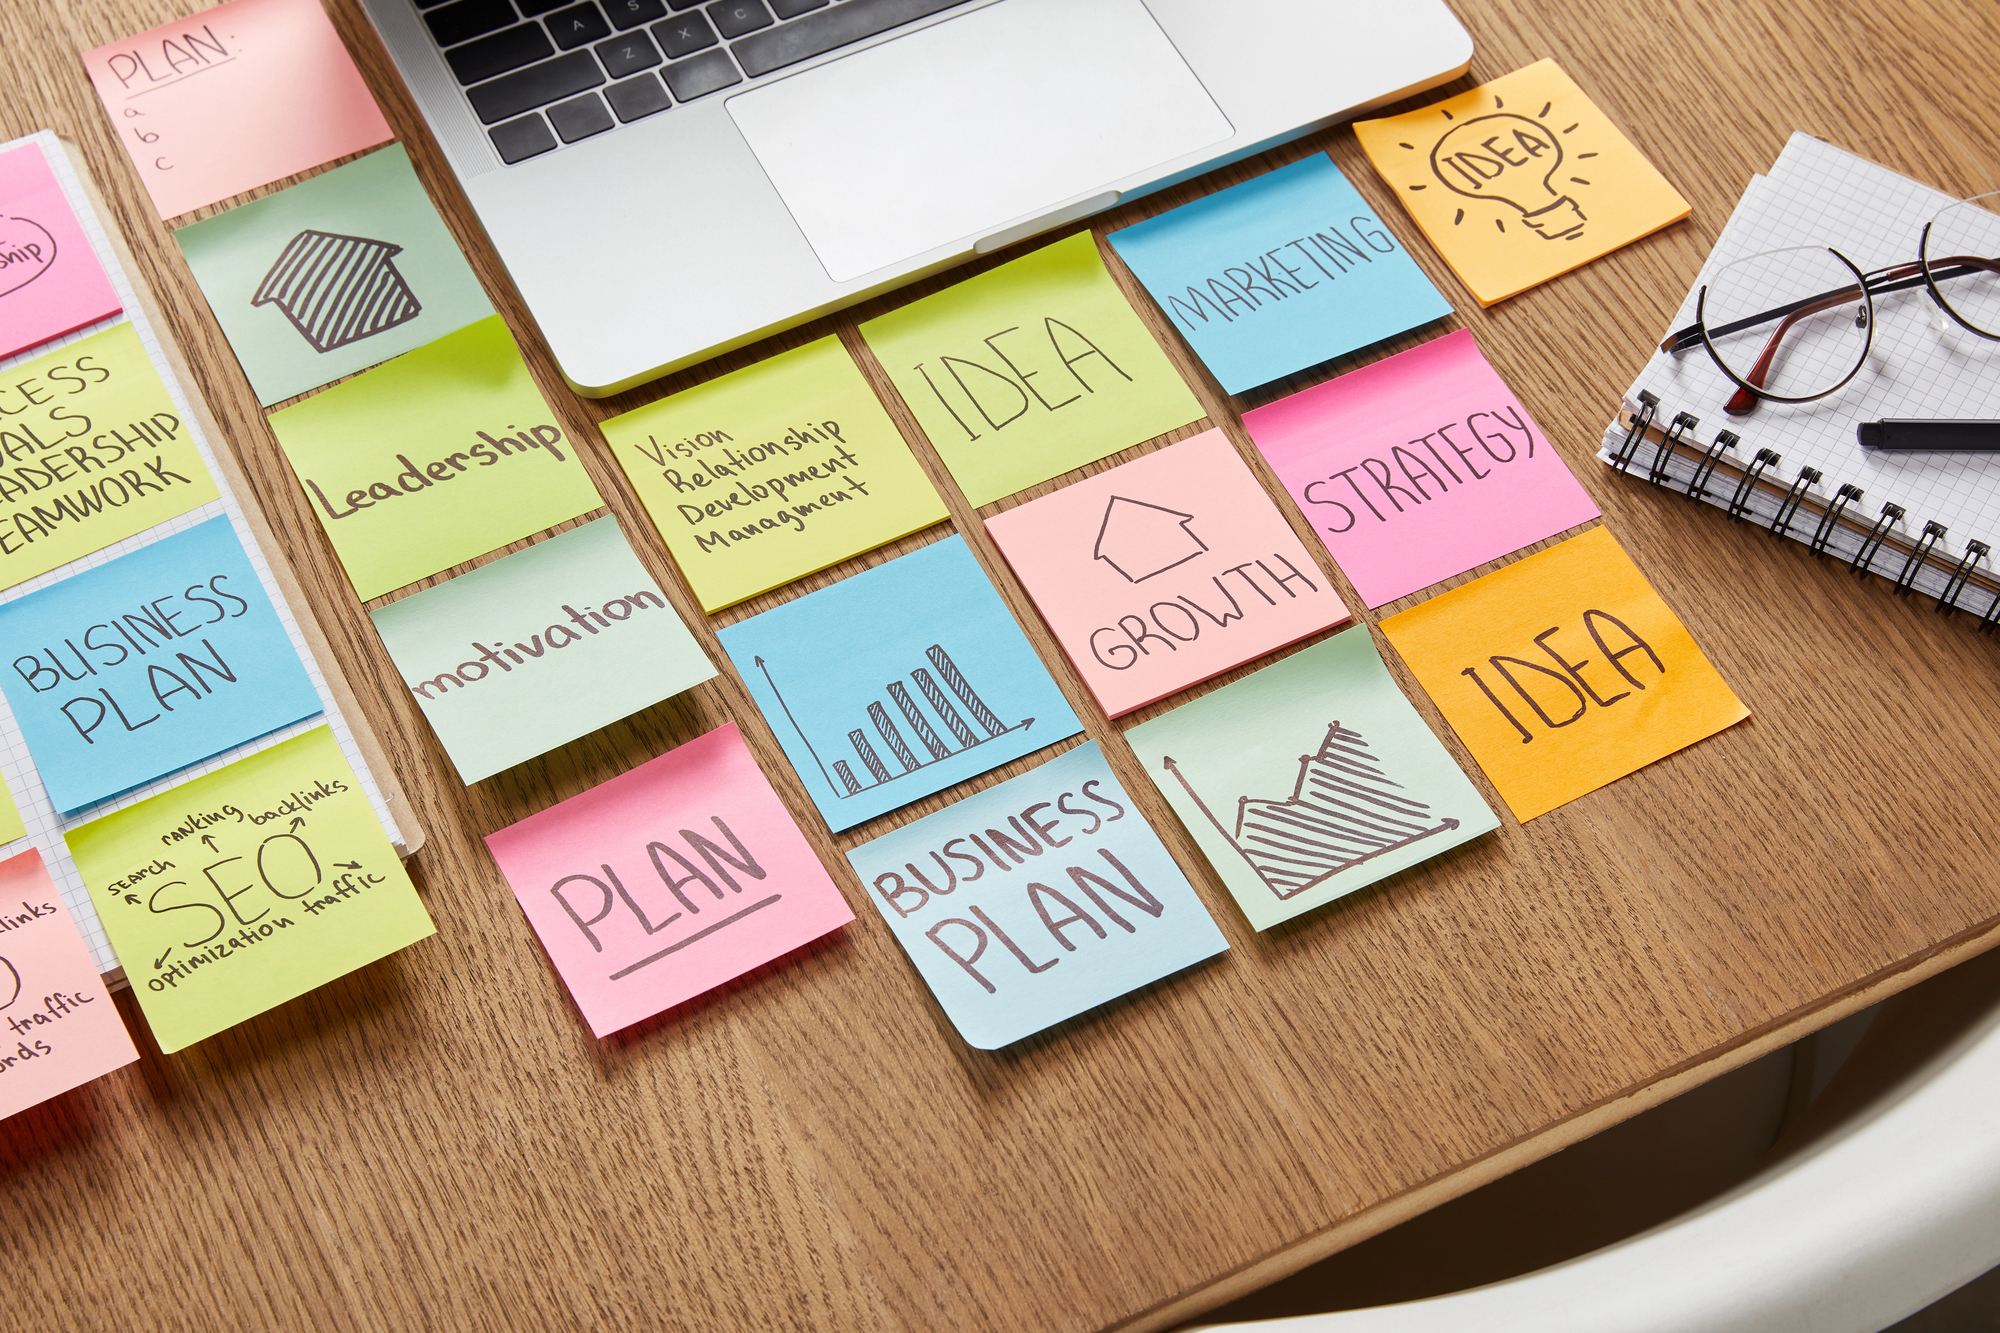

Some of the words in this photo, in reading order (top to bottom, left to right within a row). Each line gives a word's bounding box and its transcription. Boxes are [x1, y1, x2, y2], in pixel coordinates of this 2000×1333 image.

[573, 19, 585, 31] A
[622, 47, 636, 59] Z
[677, 28, 691, 40] X
[734, 8, 747, 20] C
[123, 107, 146, 118] a
[134, 127, 160, 144] b
[1441, 127, 1551, 190] IDEA
[1167, 215, 1396, 332] MARKETING
[913, 316, 1134, 442] IDEA
[305, 424, 567, 520] Leadership
[634, 429, 735, 467] Vision
[662, 420, 848, 494] Relationship
[676, 444, 857, 526] Development
[1303, 405, 1535, 534] STRATEGY
[693, 475, 870, 554] Managment
[13, 575, 249, 694] BUSINESS
[411, 590, 667, 700] motivation
[1088, 553, 1319, 671] GROWTH
[60, 639, 238, 746] PLAN
[1460, 609, 1666, 745] IDEA
[248, 780, 349, 826] backlinks
[549, 815, 768, 953] PLAN
[873, 779, 1126, 918] BUSINESS
[148, 832, 323, 949] SEO
[303, 872, 387, 916] traffic
[925, 848, 1165, 995] PLAN
[7, 992, 95, 1037] traffic
